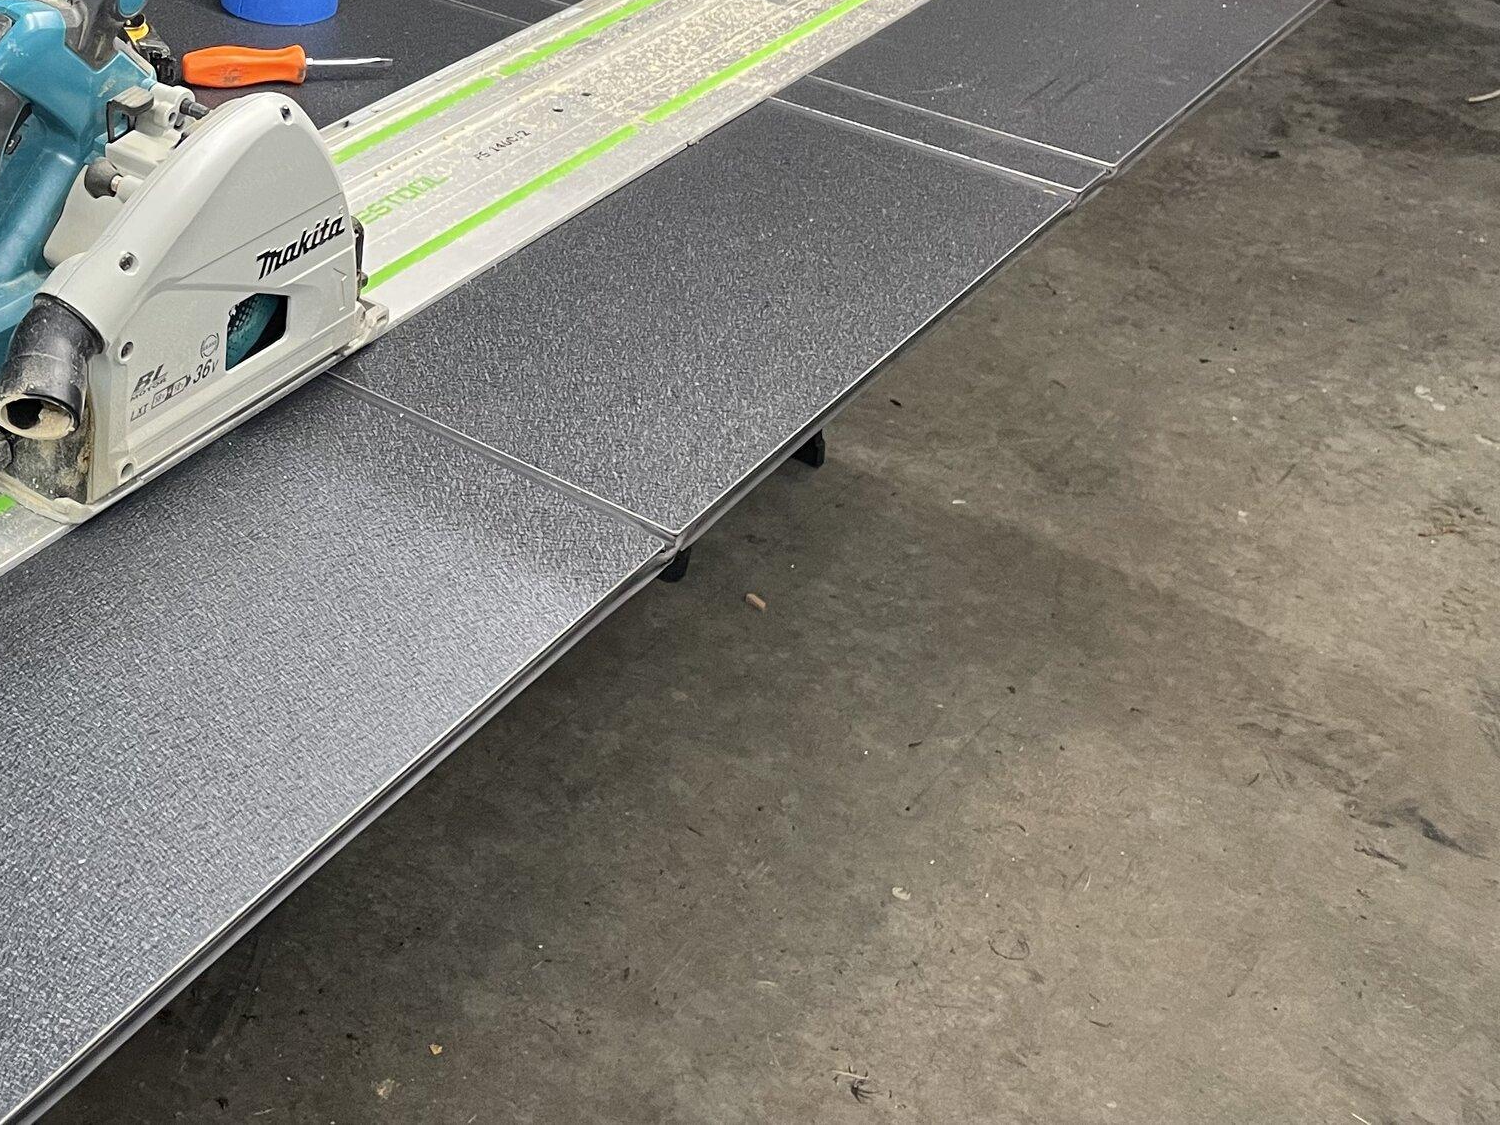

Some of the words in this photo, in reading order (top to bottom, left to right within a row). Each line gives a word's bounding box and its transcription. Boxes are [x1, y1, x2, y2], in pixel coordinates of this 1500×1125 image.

[353, 176, 450, 225] ESTOOL
[256, 213, 345, 281] makita
[133, 363, 165, 394] BL
[193, 359, 219, 384] 36V
